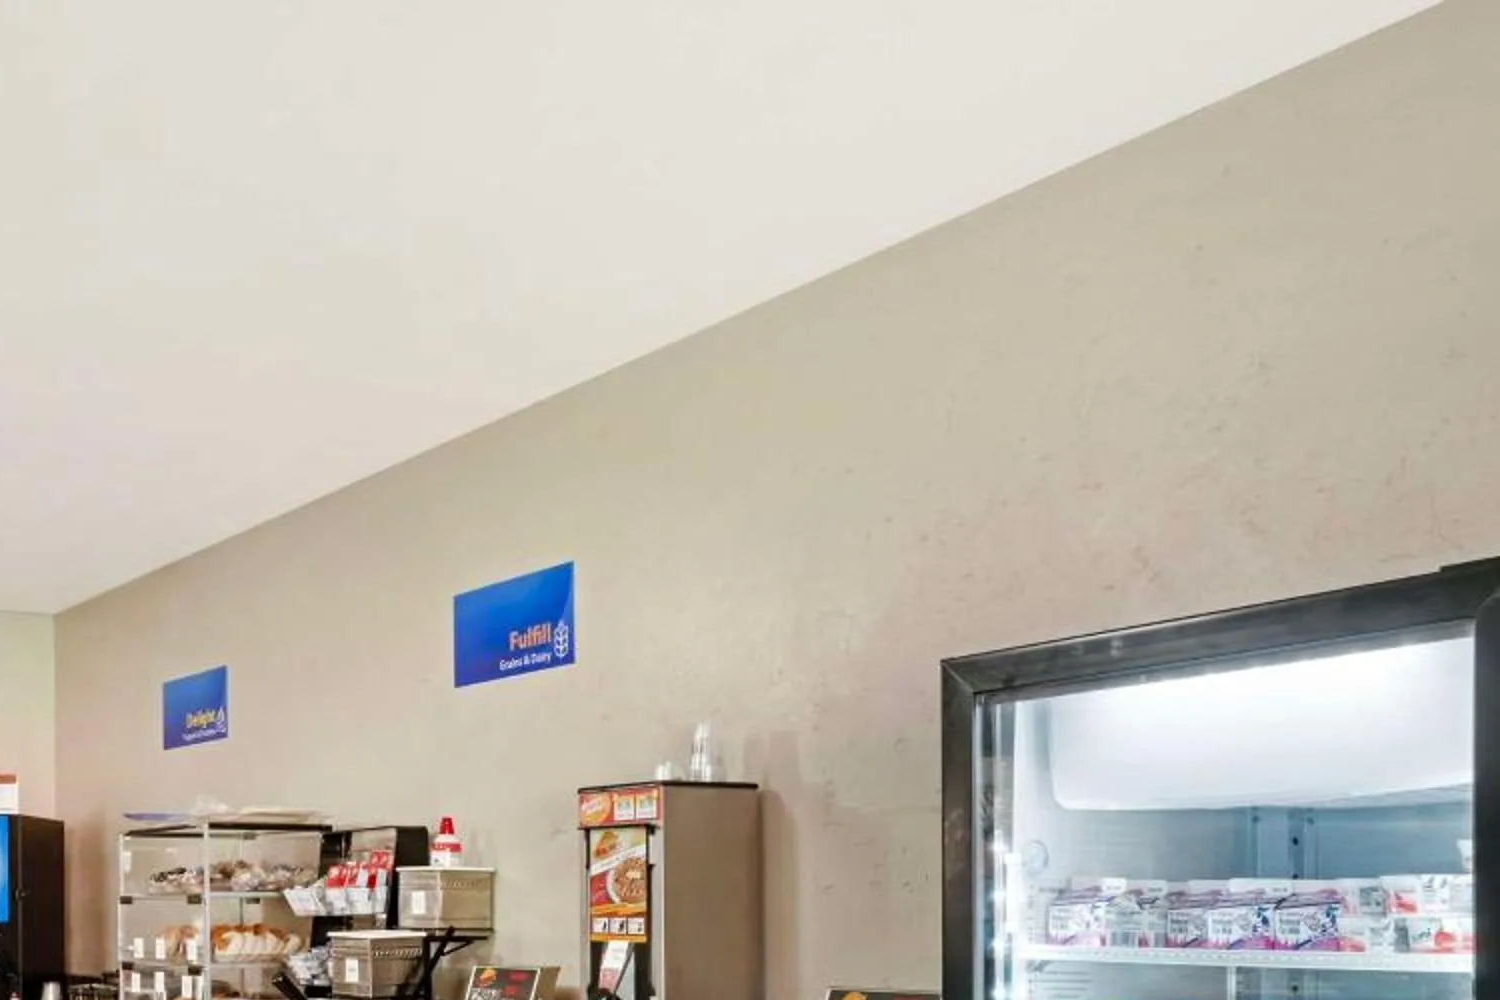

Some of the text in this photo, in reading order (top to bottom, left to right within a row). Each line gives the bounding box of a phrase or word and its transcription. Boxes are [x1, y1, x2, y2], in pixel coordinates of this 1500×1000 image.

[509, 622, 552, 651] Fulfill
[500, 657, 522, 671] Grains
[532, 652, 552, 664] Dairy
